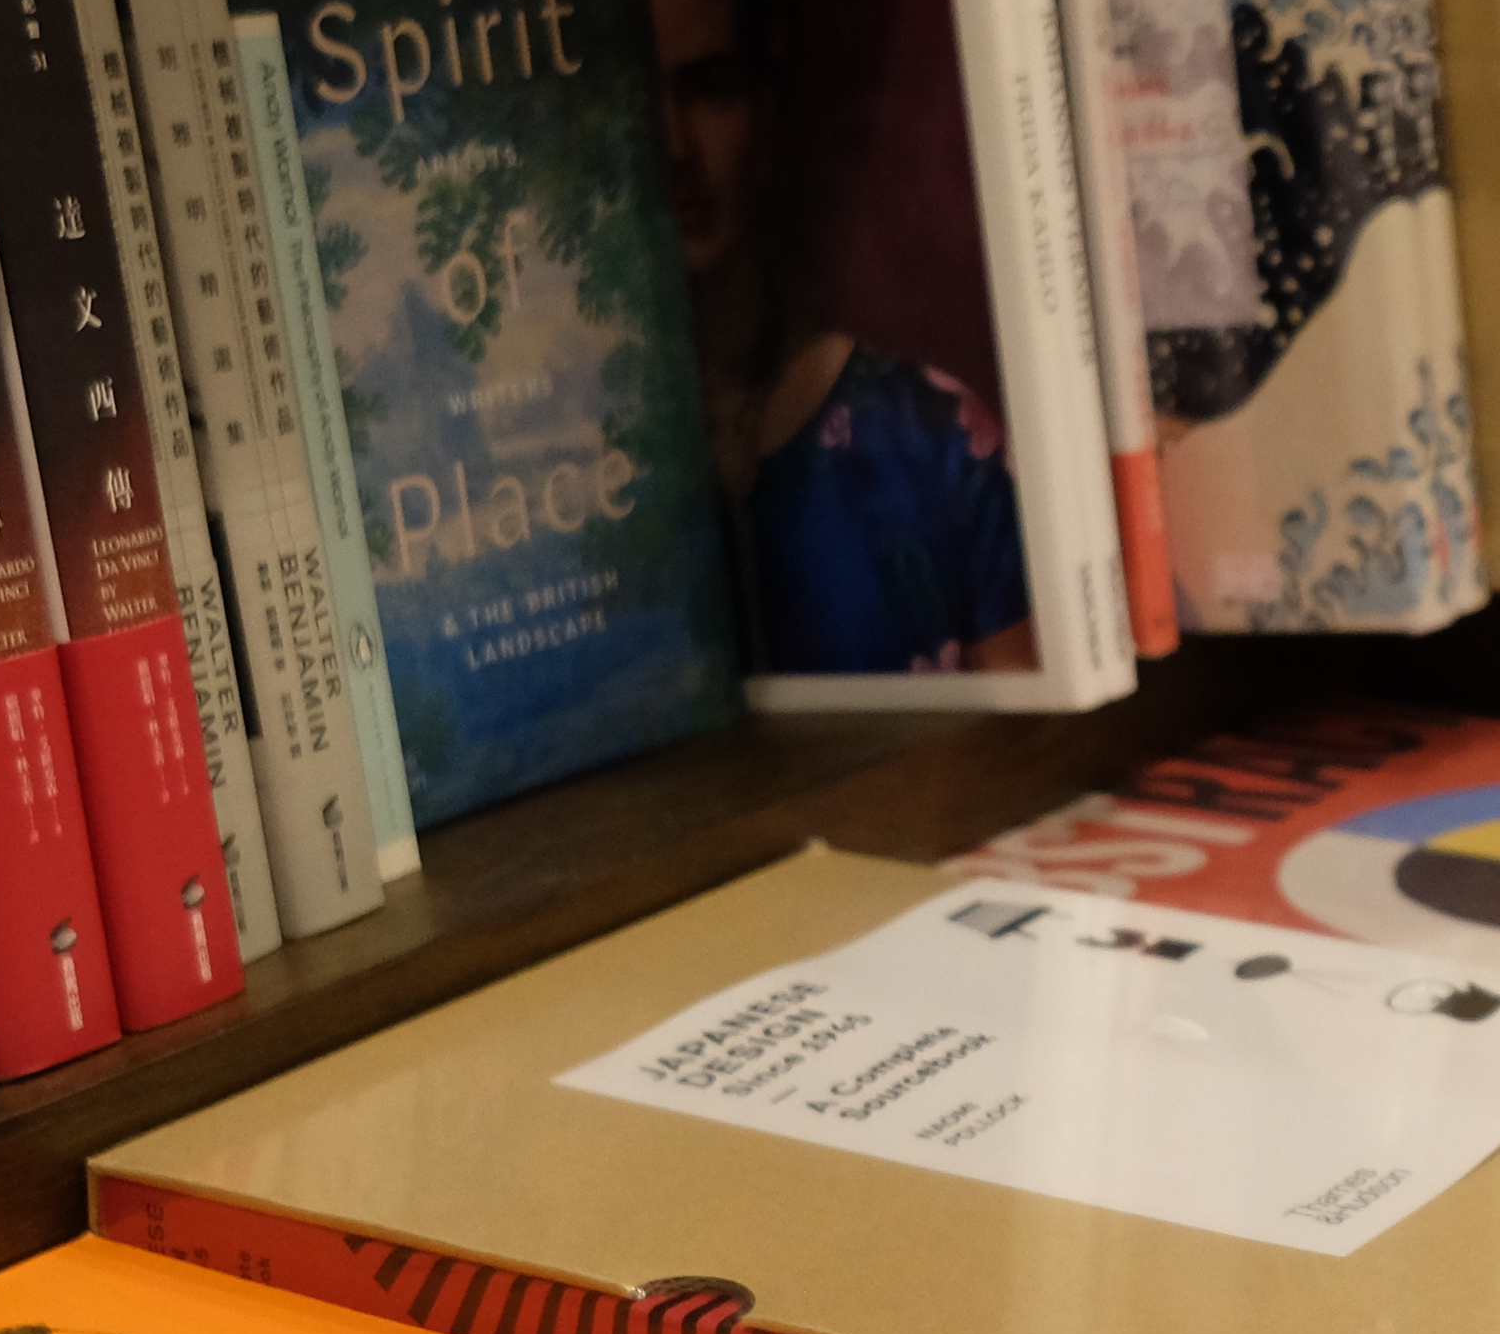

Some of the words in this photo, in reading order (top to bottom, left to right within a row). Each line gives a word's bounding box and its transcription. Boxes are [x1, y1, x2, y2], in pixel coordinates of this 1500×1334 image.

[438, 207, 530, 330] of
[51, 195, 137, 515] 達文西傳
[91, 524, 166, 561] LEONARDO
[388, 439, 637, 573] Place
[97, 556, 120, 580] DA
[121, 548, 160, 573] VINCI
[100, 581, 120, 601] BY
[466, 597, 517, 633] THE
[521, 567, 620, 620] BRITISH
[102, 594, 160, 624] WALTER
[300, 543, 344, 701] WALTER
[462, 611, 610, 673] LANDSCAPE
[173, 583, 230, 791] BENJAMIN
[197, 573, 241, 736] WALTER
[276, 549, 331, 754] BENJAMIN
[638, 978, 833, 1084] JAPANESE
[672, 1006, 831, 1094] DESIGN
[720, 1039, 808, 1100] Since
[831, 1022, 964, 1103] Complete
[837, 1029, 1000, 1125] Sourcebook
[915, 1099, 983, 1142] NAOMI
[942, 1090, 1032, 1148] POLLOCK
[1284, 1166, 1380, 1221] Thames
